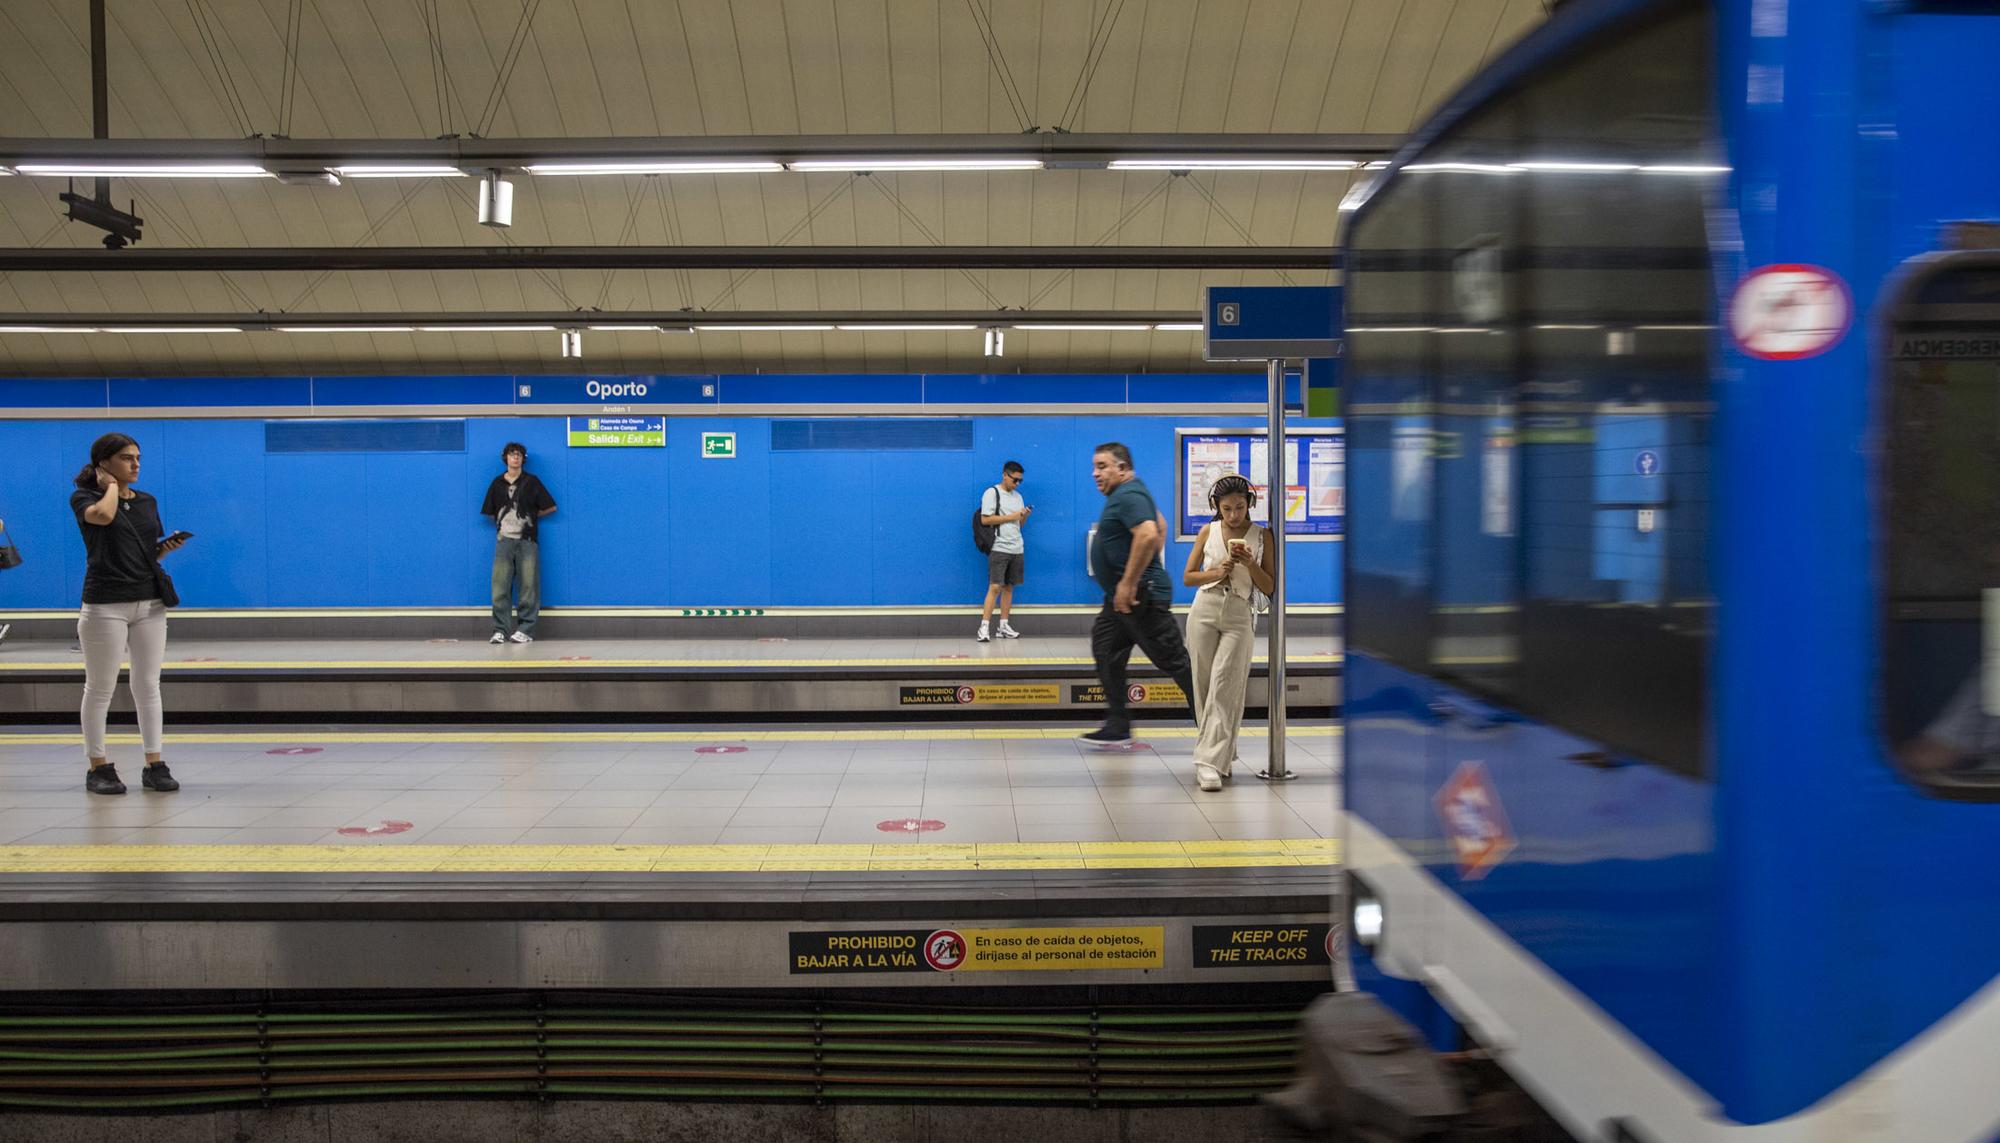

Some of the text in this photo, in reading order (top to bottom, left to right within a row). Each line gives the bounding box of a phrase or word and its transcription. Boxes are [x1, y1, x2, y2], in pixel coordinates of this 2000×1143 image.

[1222, 306, 1234, 323] 6
[586, 380, 647, 400] Oporto
[588, 434, 620, 444] Salida
[627, 434, 644, 444] Exit
[903, 696, 926, 704] BAJAR
[942, 694, 955, 702] VÍA
[916, 688, 954, 696] PROHIBIDO
[1079, 694, 1094, 702] THE
[828, 935, 916, 950] PROHIBIDO
[975, 934, 1143, 946] En caso de caída de objetos,
[1231, 929, 1309, 943] KEEP OFF
[798, 950, 916, 968] BAJAR A LA VÍA
[1021, 950, 1032, 960] al
[1035, 949, 1086, 962] personal
[1089, 949, 1104, 959] de
[1107, 948, 1157, 959] estación
[1210, 947, 1307, 962] THE TRACKS
